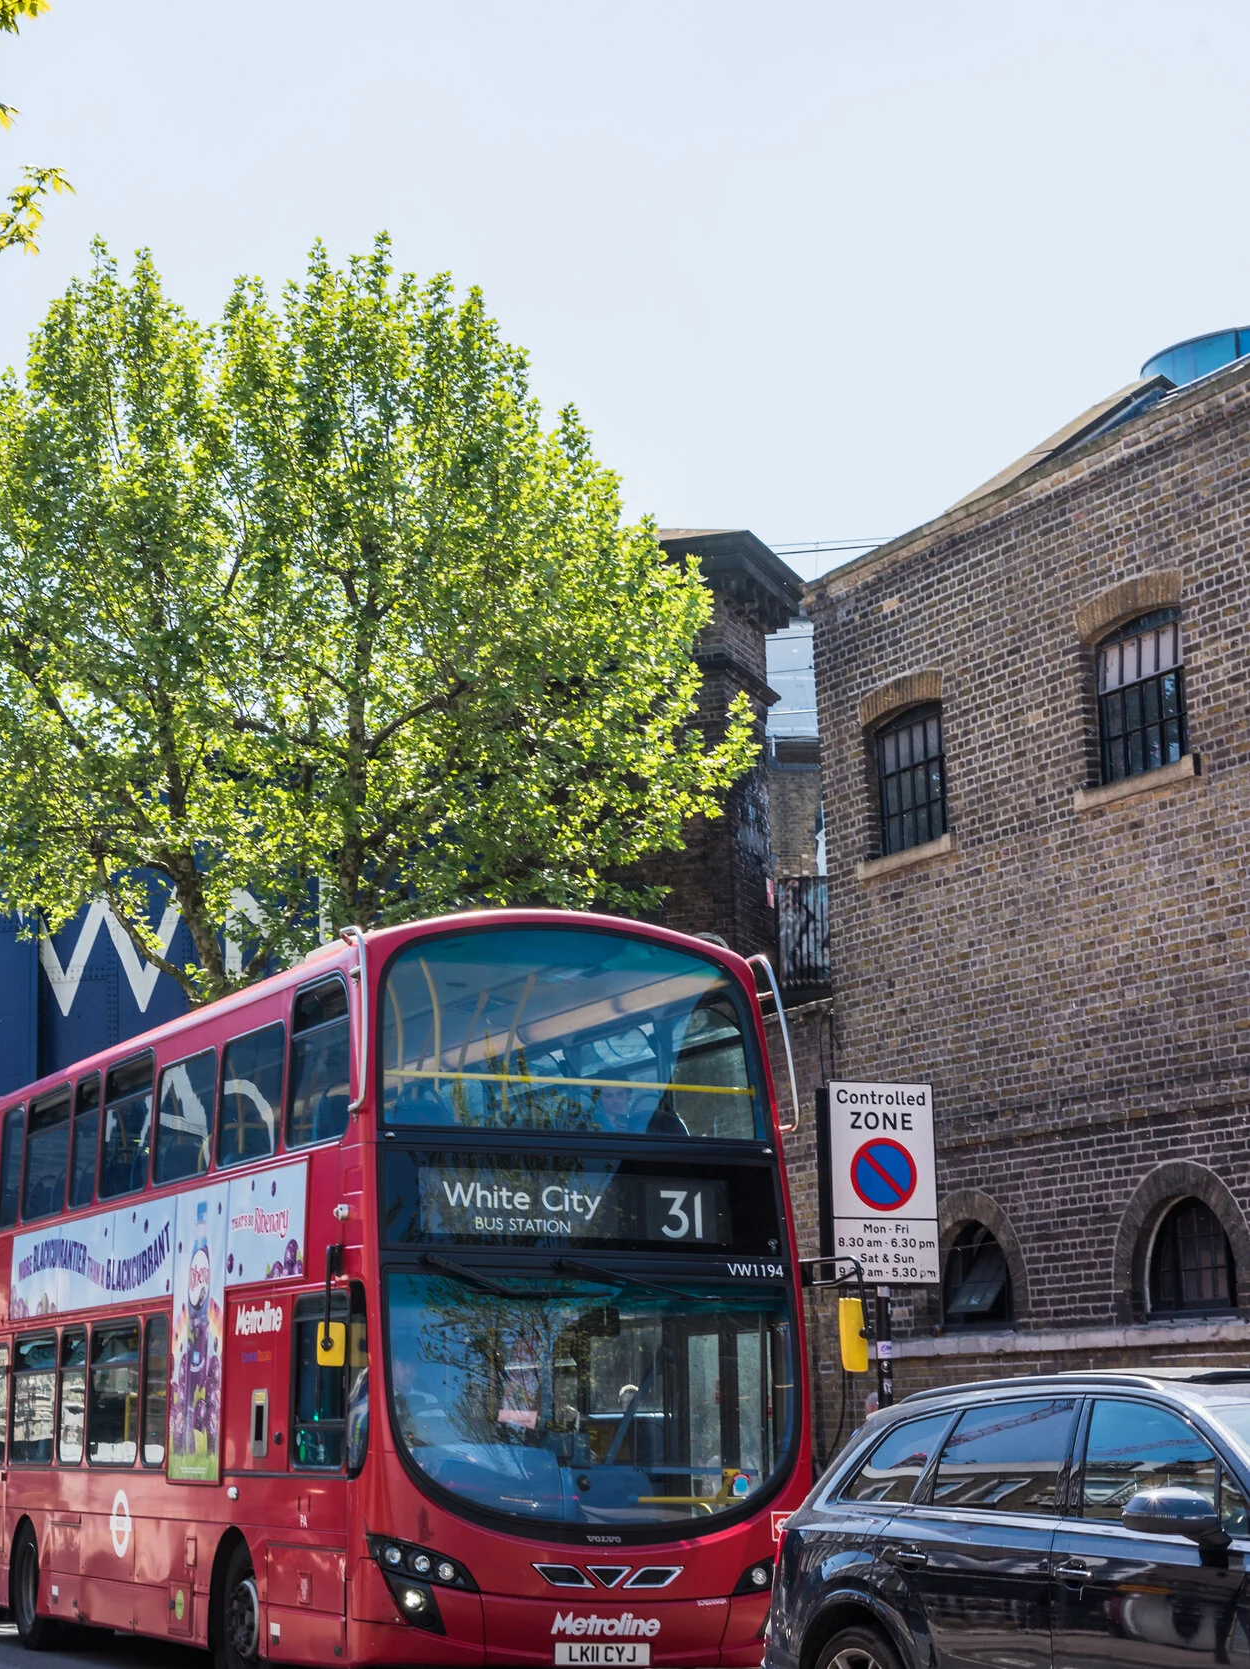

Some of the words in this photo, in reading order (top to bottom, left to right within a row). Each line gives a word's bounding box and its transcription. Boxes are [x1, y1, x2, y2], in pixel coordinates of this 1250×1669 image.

[836, 1089, 926, 1106] Controlled
[850, 1111, 913, 1131] ZONE
[443, 1181, 531, 1210] White
[542, 1186, 601, 1221] City
[660, 1190, 704, 1239] 31
[475, 1216, 504, 1232] BUS
[509, 1217, 572, 1234] STATION
[863, 1223, 887, 1234] Mon
[895, 1224, 910, 1234] Fri
[838, 1237, 864, 1247] 8.30
[866, 1239, 883, 1248] am
[891, 1238, 917, 1248] 6.30
[919, 1240, 936, 1250] pm
[18, 1254, 33, 1282] MORE
[33, 1238, 87, 1274] BLACKCURRANTIER
[87, 1255, 100, 1287] THAN
[105, 1220, 170, 1293] BLACKCURRANT
[860, 1253, 879, 1263] Sat
[882, 1253, 890, 1264] &
[893, 1253, 915, 1264] Sun
[726, 1262, 785, 1278] VW1194
[867, 1269, 883, 1277] am
[892, 1267, 918, 1278] 5.30
[920, 1270, 936, 1279] pm
[235, 1300, 283, 1336] Metroline
[586, 1535, 622, 1543] VOLVO
[550, 1611, 661, 1637] Metroline
[569, 1645, 599, 1662] LK11
[604, 1646, 637, 1662] CYJ
